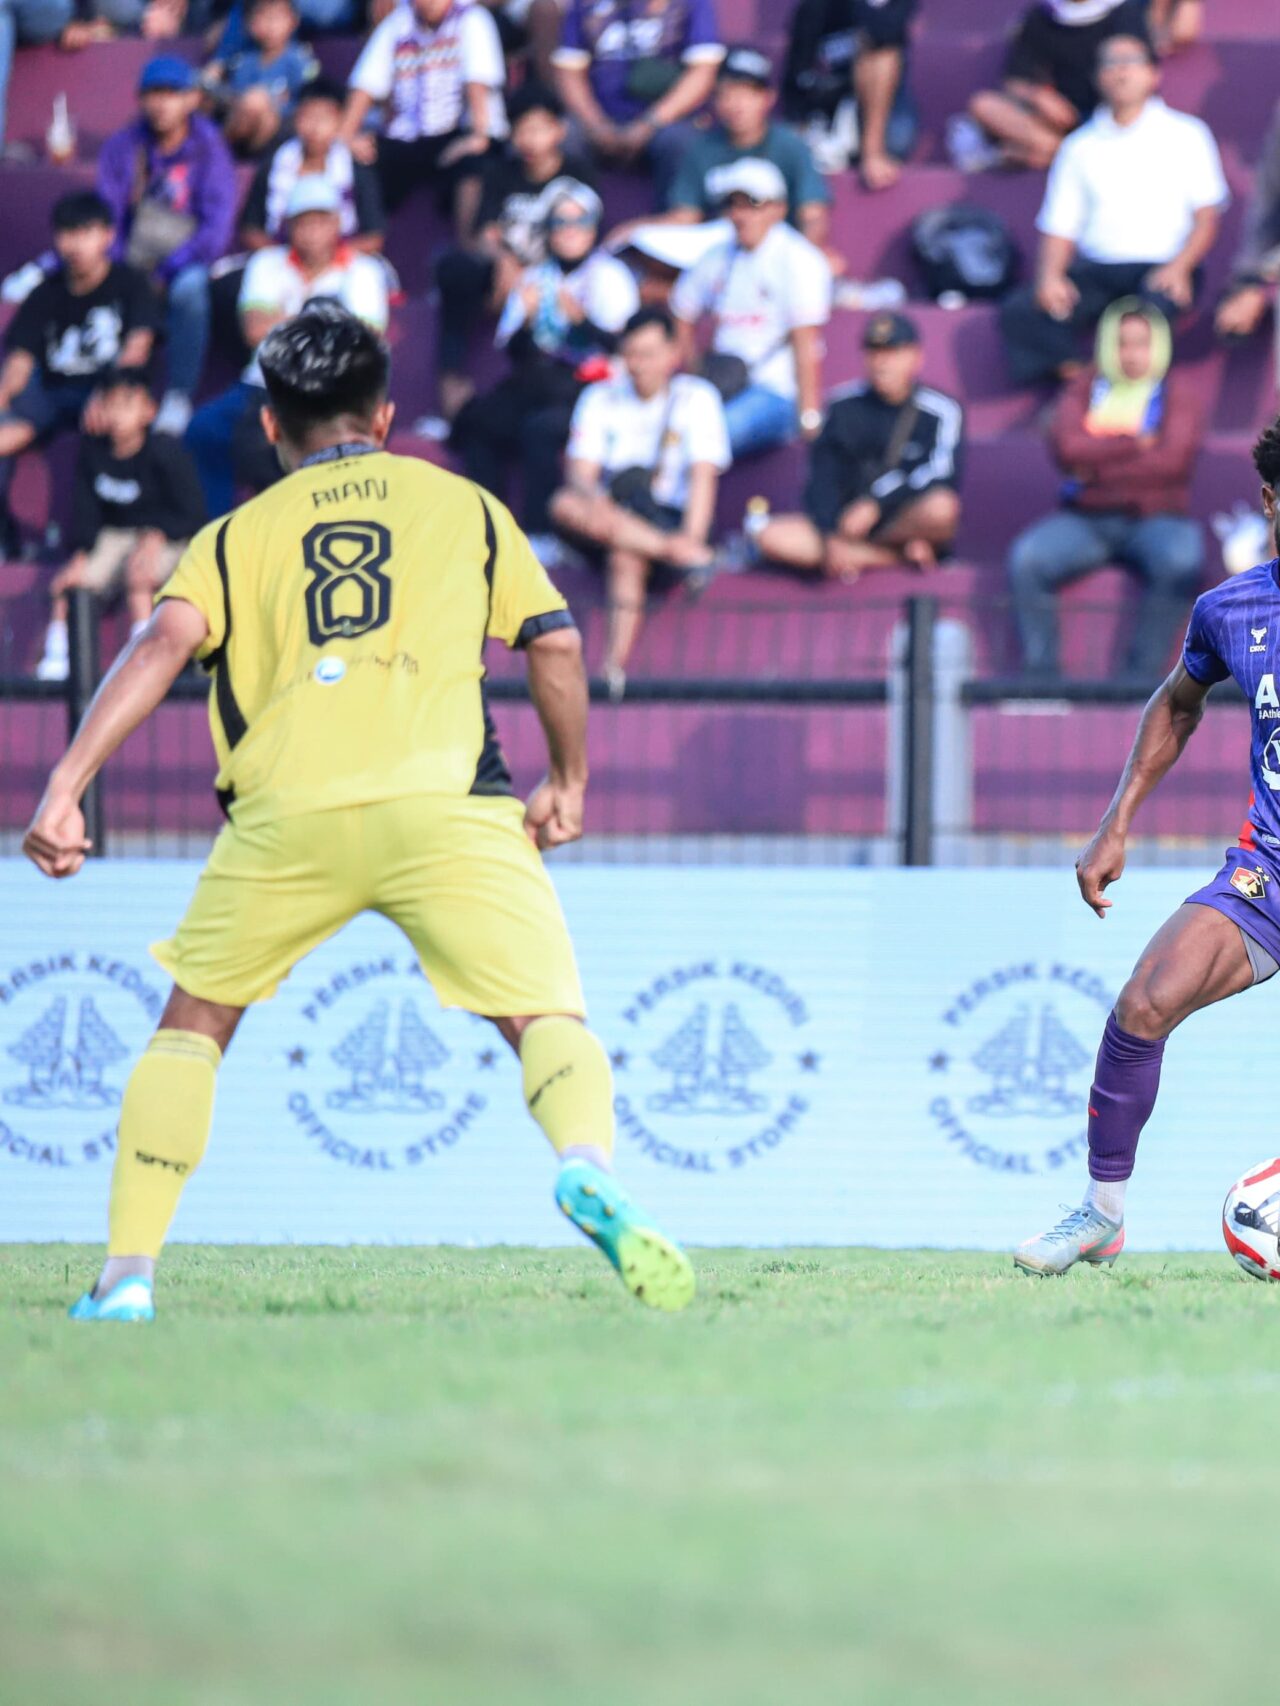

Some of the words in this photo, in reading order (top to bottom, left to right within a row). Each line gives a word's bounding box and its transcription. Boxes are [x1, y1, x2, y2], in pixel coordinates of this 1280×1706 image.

[312, 478, 387, 509] RIAN
[302, 520, 391, 647] 8
[287, 1091, 393, 1170] OFFICIAL
[406, 1091, 488, 1166] STORE
